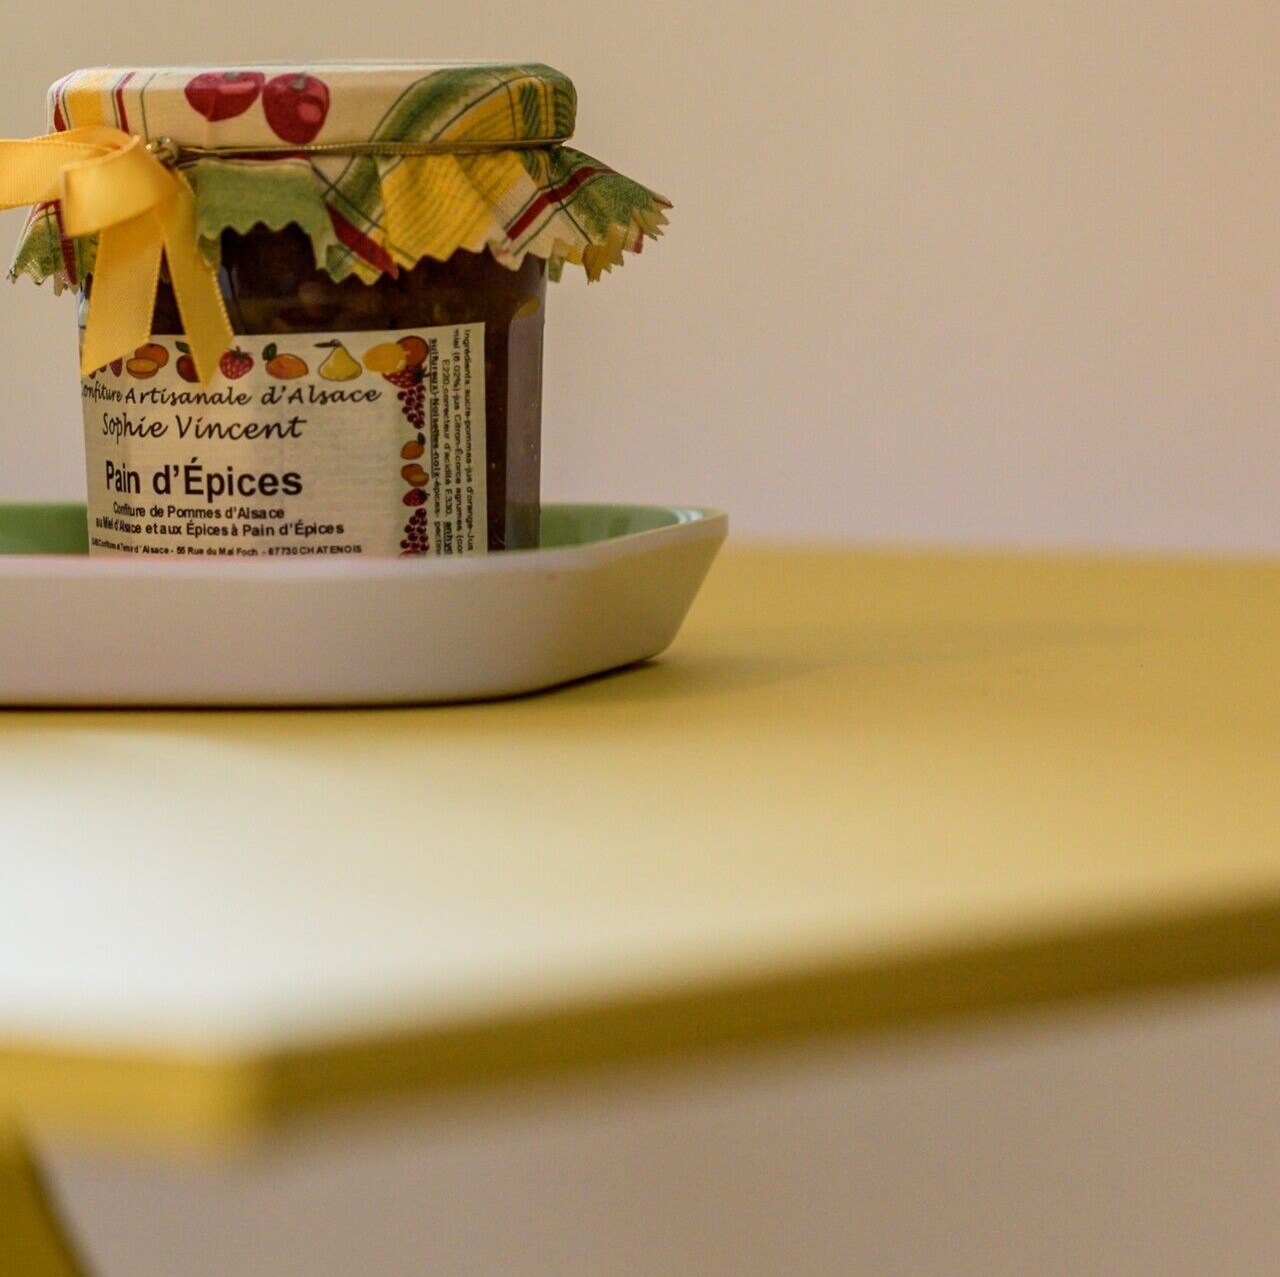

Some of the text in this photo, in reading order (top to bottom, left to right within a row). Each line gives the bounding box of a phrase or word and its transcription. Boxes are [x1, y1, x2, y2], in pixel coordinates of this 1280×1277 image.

[125, 386, 252, 406] Artisanale
[103, 412, 307, 444] Sophie Vincent
[106, 457, 303, 503] Pain d'Épices
[150, 505, 164, 518] de
[167, 505, 222, 519] Pommes
[225, 507, 285, 520] d'Alsace
[186, 519, 229, 538] Épices
[242, 524, 275, 536] Pain
[278, 519, 345, 538] d'Épices
